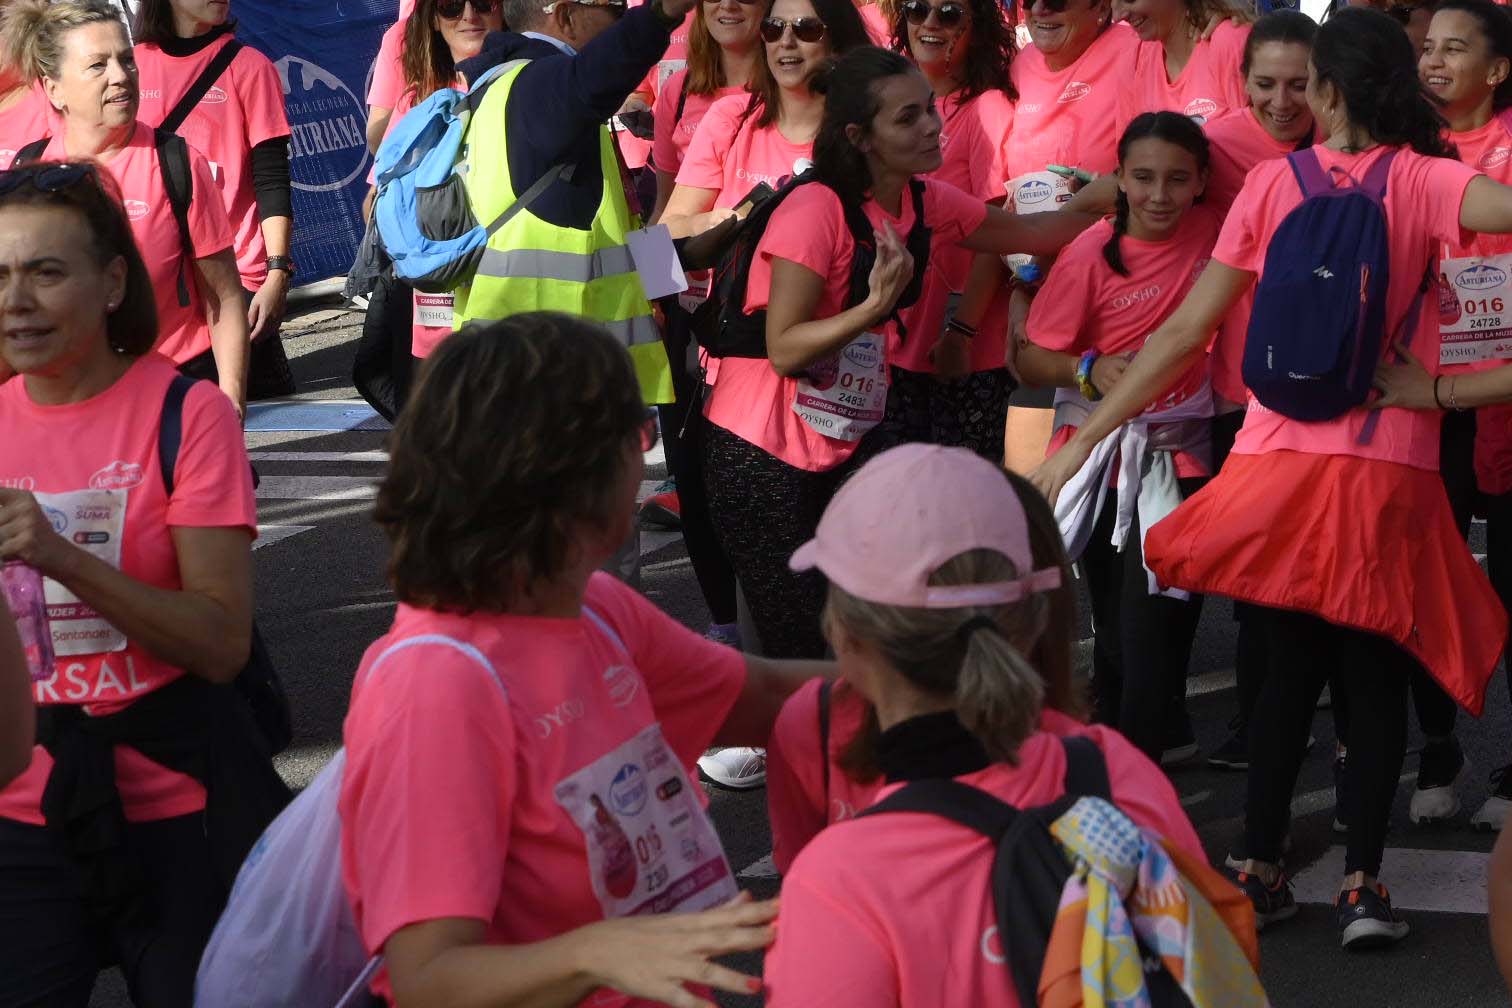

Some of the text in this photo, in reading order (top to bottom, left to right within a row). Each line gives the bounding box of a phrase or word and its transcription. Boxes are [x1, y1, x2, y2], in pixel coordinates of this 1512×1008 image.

[735, 168, 778, 185] OYSHO
[1459, 273, 1503, 286] ASTURIANA
[1112, 285, 1160, 310] OYSHO
[1464, 297, 1504, 314] 016
[1470, 317, 1501, 329] 24728
[840, 372, 875, 393] 016
[74, 510, 111, 522] SUMA
[52, 629, 112, 642] Santander
